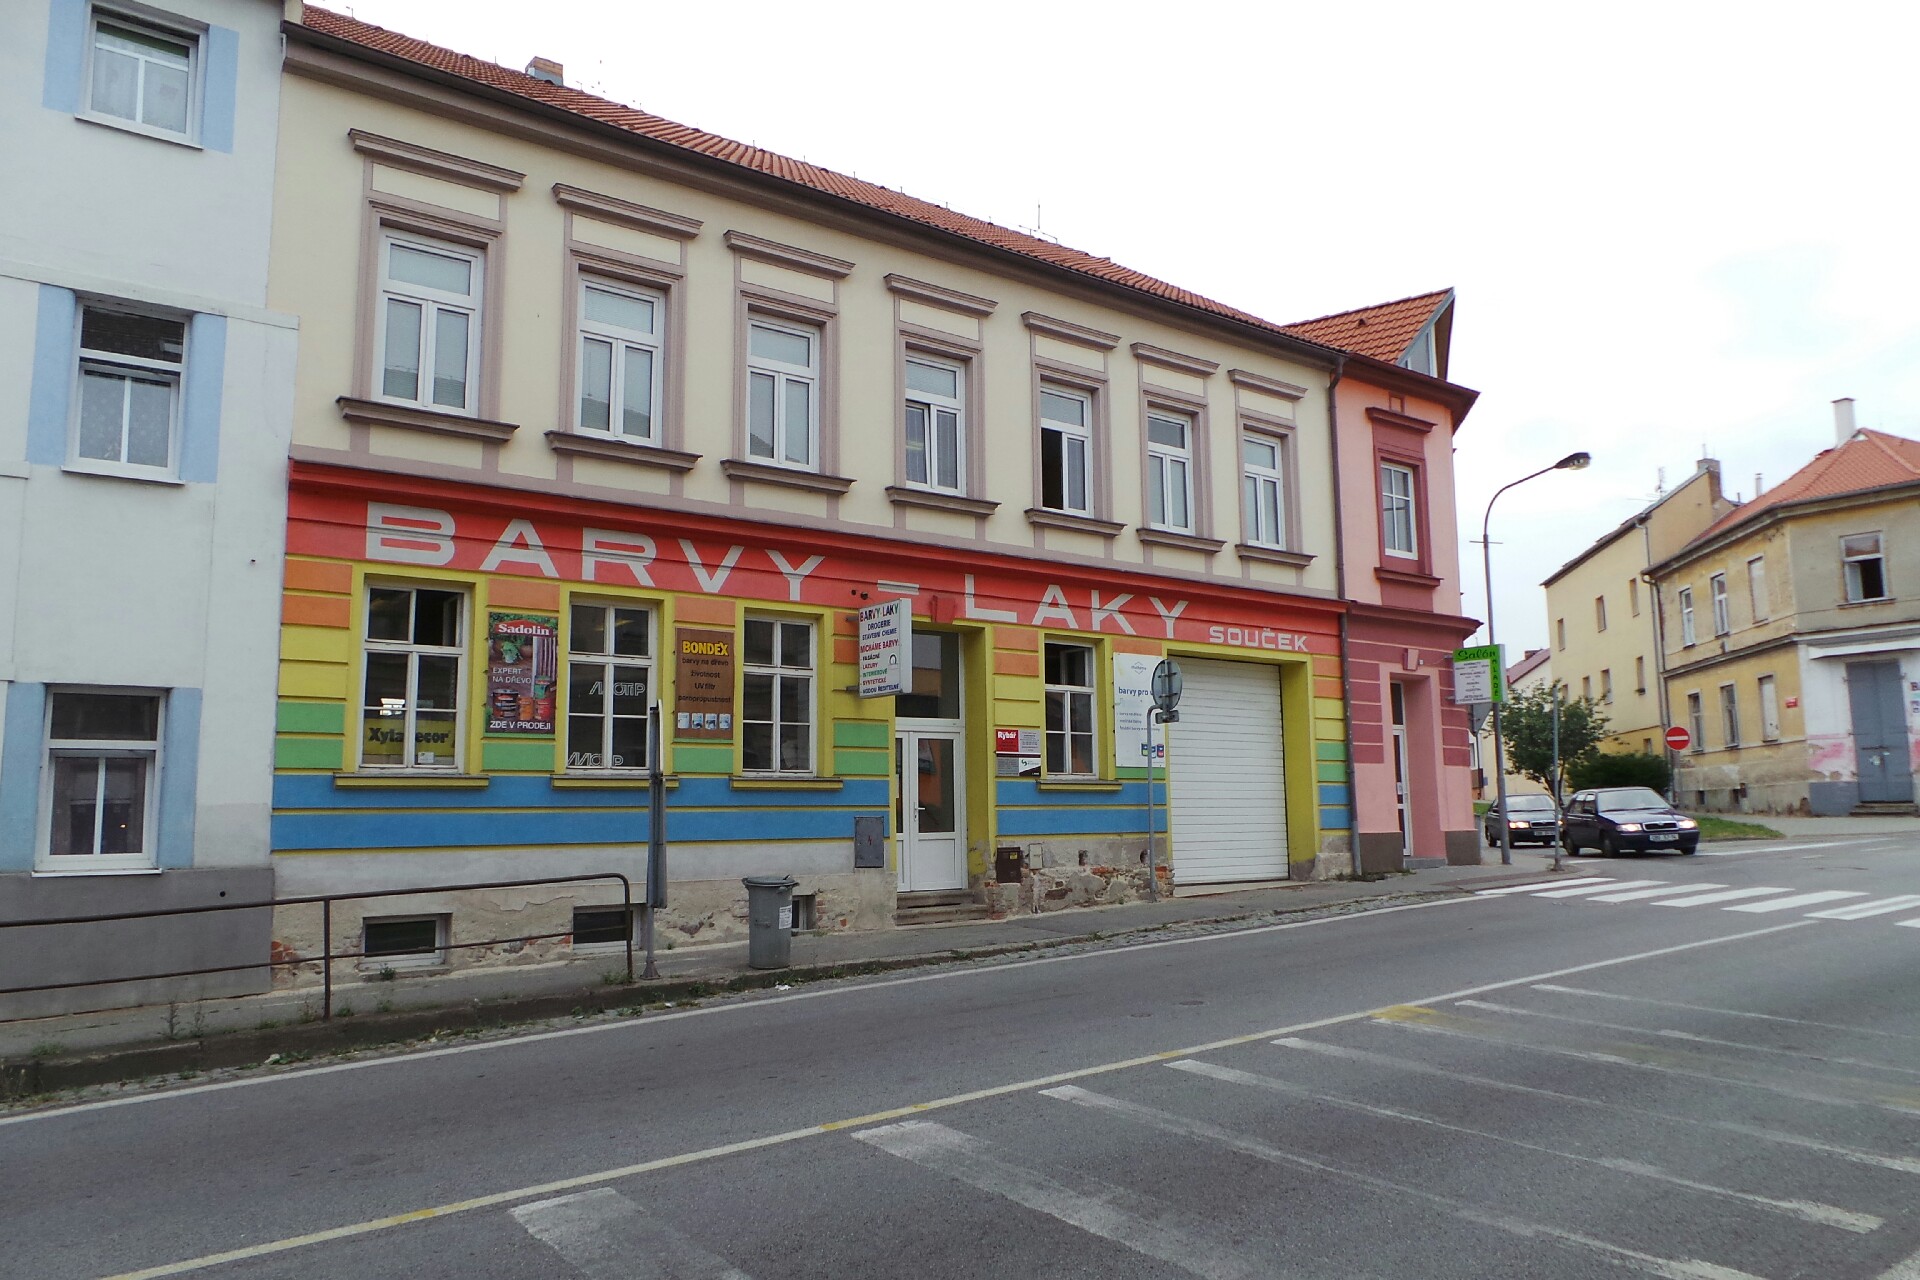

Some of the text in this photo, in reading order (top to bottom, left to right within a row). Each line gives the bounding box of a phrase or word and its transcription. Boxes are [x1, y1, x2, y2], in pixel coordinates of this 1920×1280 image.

[365, 501, 826, 601] BARVY
[965, 574, 1189, 639] LAKY
[882, 603, 899, 617] LAKY
[498, 623, 550, 636] Sadolin
[867, 619, 891, 631] DROGERIE
[881, 627, 897, 637] CHEMIE
[1208, 625, 1309, 653] SOUČEK
[682, 640, 729, 656] BONDEX
[682, 657, 699, 665] barvy
[1457, 649, 1496, 661] Salón
[492, 667, 523, 675] EXPERT
[862, 662, 879, 670] LAZURY
[492, 675, 504, 683] NA
[505, 675, 532, 684] DŘEVO
[1118, 686, 1136, 697] barvy
[1137, 689, 1149, 697] pro
[490, 720, 551, 730] ZDE V PRODEJI
[368, 727, 449, 745] Xylaecor
[568, 751, 624, 766] MOP
